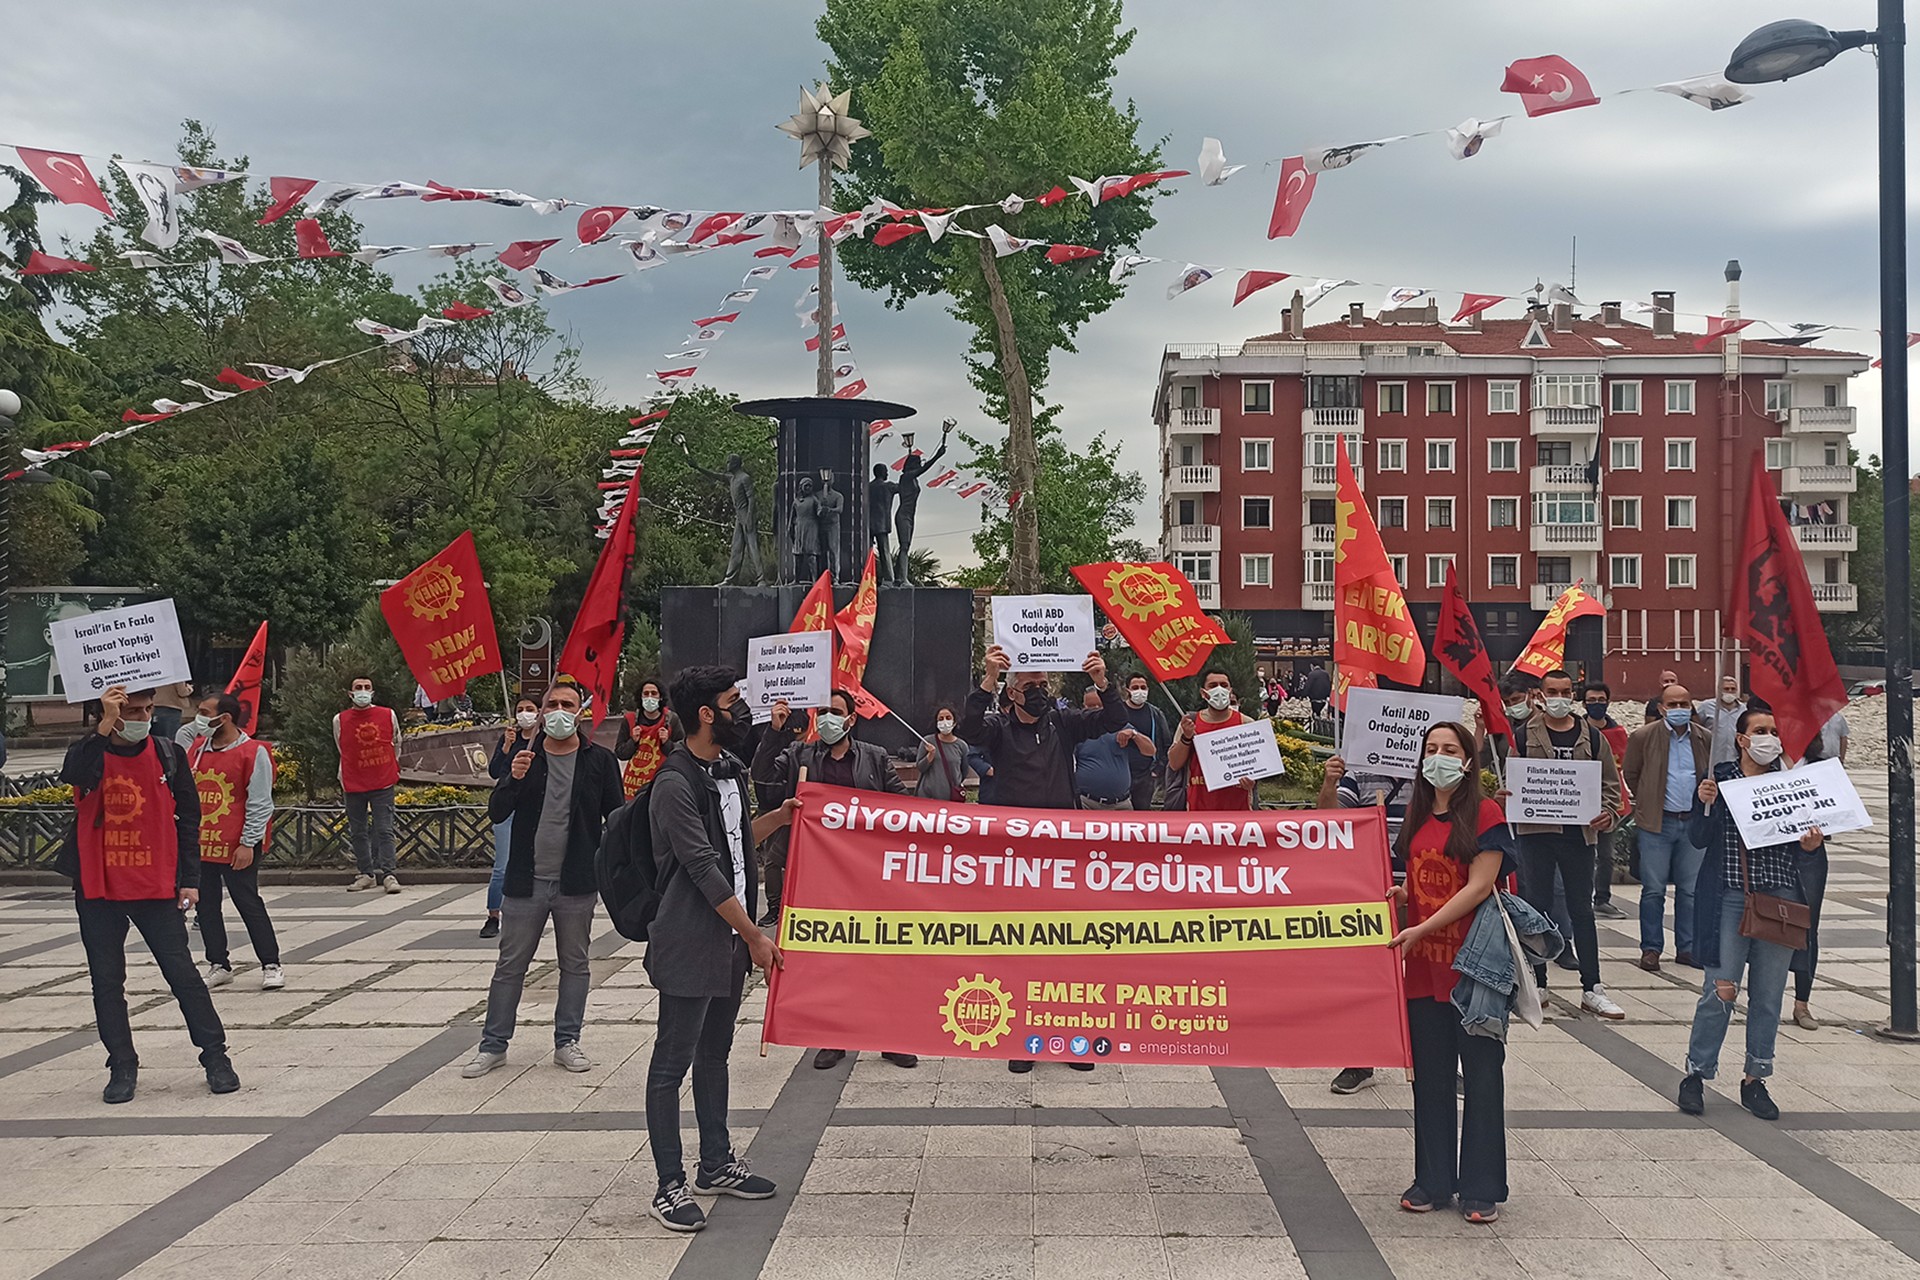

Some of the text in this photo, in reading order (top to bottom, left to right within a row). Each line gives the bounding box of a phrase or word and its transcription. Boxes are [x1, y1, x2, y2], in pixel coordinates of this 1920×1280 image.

[1022, 608, 1064, 619] Katil ABD
[74, 614, 155, 639] İsrail'in En Fazla
[1012, 622, 1075, 635] Ortadoğu'dan
[1148, 616, 1202, 651] EMEK
[83, 633, 154, 655] İhracat Yaptığı
[1031, 636, 1059, 647] Defol!
[1345, 620, 1414, 664] ARTİSİ
[83, 648, 161, 673] 8.Ülke: Türkiye!
[776, 660, 816, 672] Anlaşmalar
[1382, 705, 1430, 721] Katil ABD
[1368, 720, 1426, 738] Ortadoğu'd
[1386, 737, 1417, 752] Defol!
[1527, 766, 1548, 774] Filistin
[1521, 787, 1581, 796] Demokratik Filistin
[1752, 777, 1811, 796] İŞGALE SON
[200, 792, 222, 804] MEP
[1751, 788, 1819, 809] FİLİSTİNE
[1751, 798, 1836, 821] ÖZGÜK!
[820, 796, 1355, 850] SİYONİST SALDIRILARA SON
[104, 830, 141, 846] MEK
[201, 830, 223, 842] EK
[106, 846, 152, 866] RTİSİ
[200, 842, 229, 858] TİSİ
[882, 843, 1292, 895] FİLİSTİN'E ÖZGÜRLÜK
[1420, 869, 1451, 886] EMEP
[788, 908, 1384, 950] İSRAİL İLE YAPILAN ANLAŞMALAR İPTAL EDİLSİN
[1027, 979, 1228, 1007] EMEK PARTİSİ
[957, 1002, 1001, 1021] EMEP
[1025, 1005, 1229, 1035] İstanbul İl Örgütü
[1139, 1041, 1229, 1056] emepistanbul
